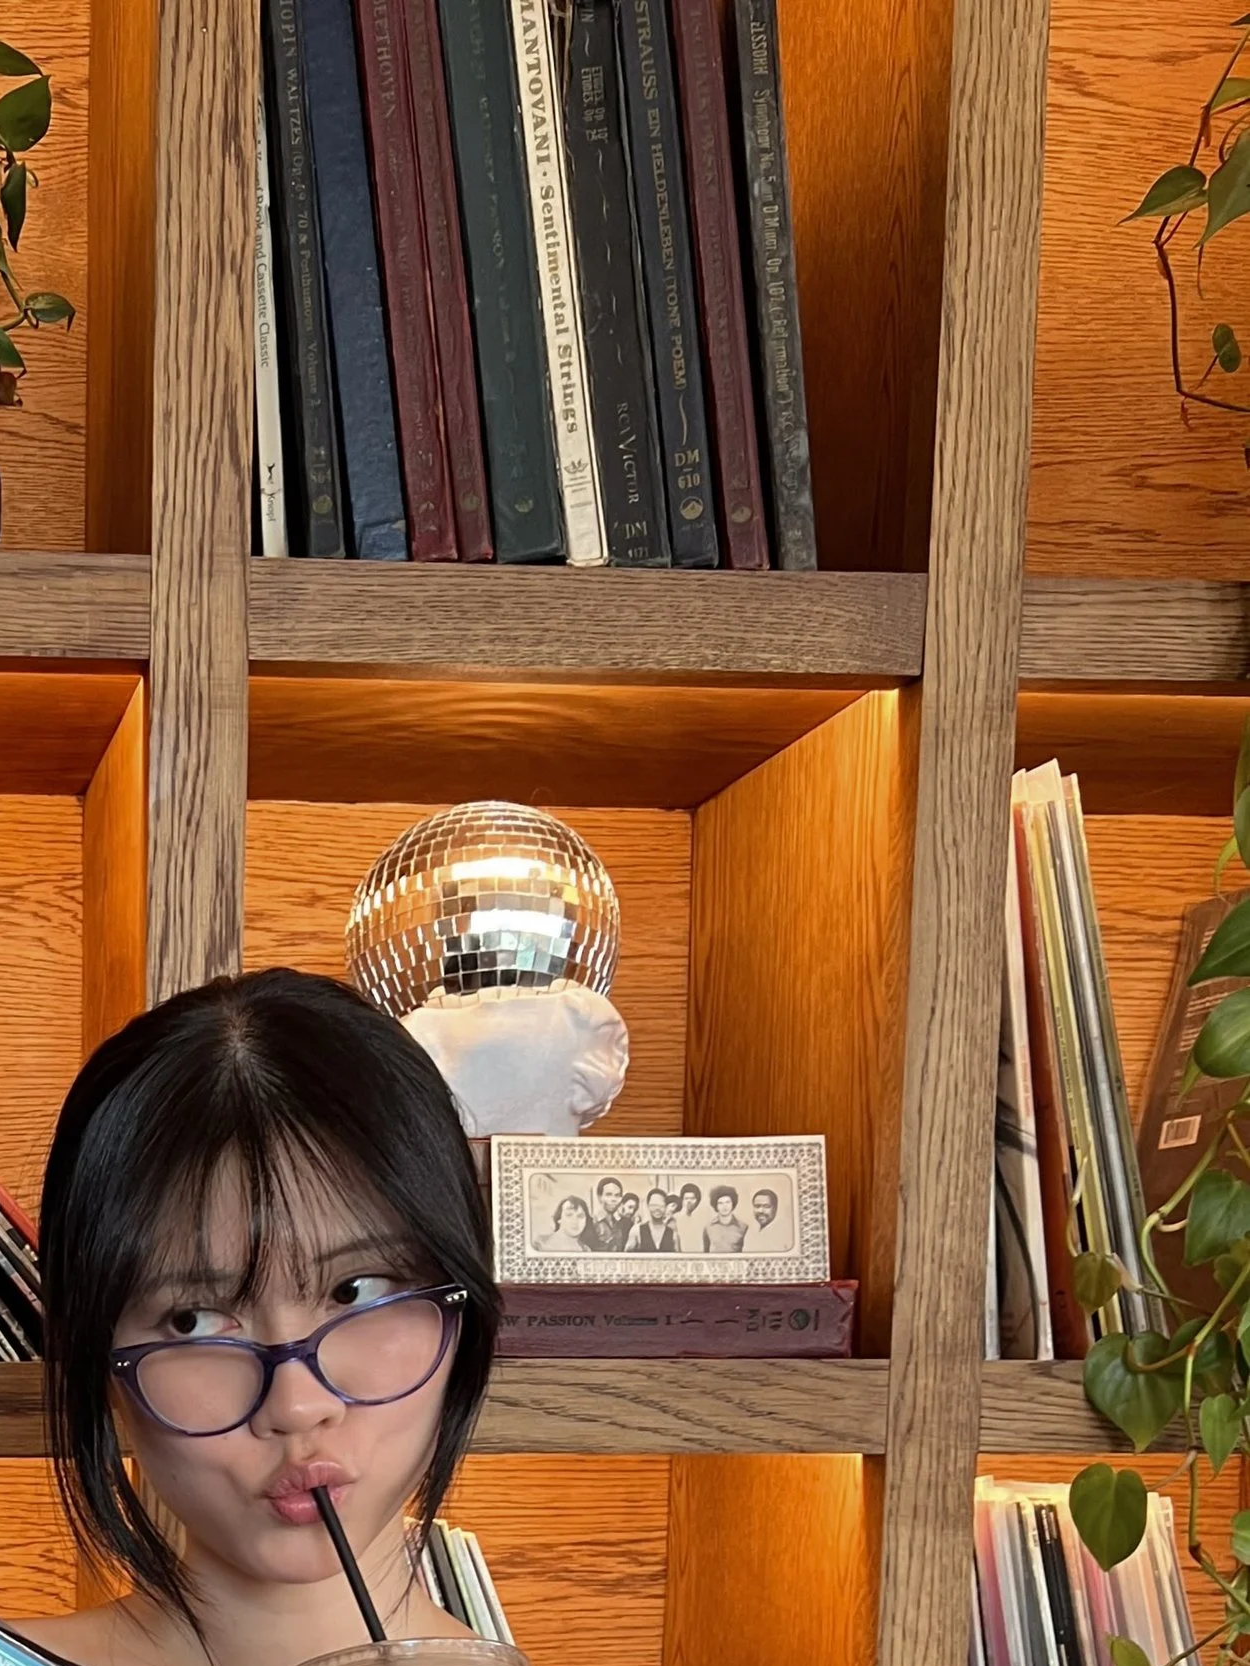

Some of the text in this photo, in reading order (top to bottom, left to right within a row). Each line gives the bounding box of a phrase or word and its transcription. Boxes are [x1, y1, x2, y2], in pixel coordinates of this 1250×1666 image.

[371, 0, 398, 117] EETHOVEN
[750, 87, 775, 149] Symphony
[284, 68, 303, 145] WALTZES
[295, 210, 308, 228] 70
[633, 0, 687, 389] STRAUSS EIN HELDENLEBEN (TONE POEM)
[254, 234, 268, 258] and
[256, 262, 269, 318] Cassette
[538, 183, 570, 335] Sentimental
[555, 342, 581, 434] Strings
[258, 322, 271, 368] Classic
[673, 447, 700, 467] DM
[676, 472, 702, 490] 610
[526, 1315, 596, 1327] PASSION
[604, 1314, 659, 1327] Vol
[746, 1308, 759, 1333] DM
